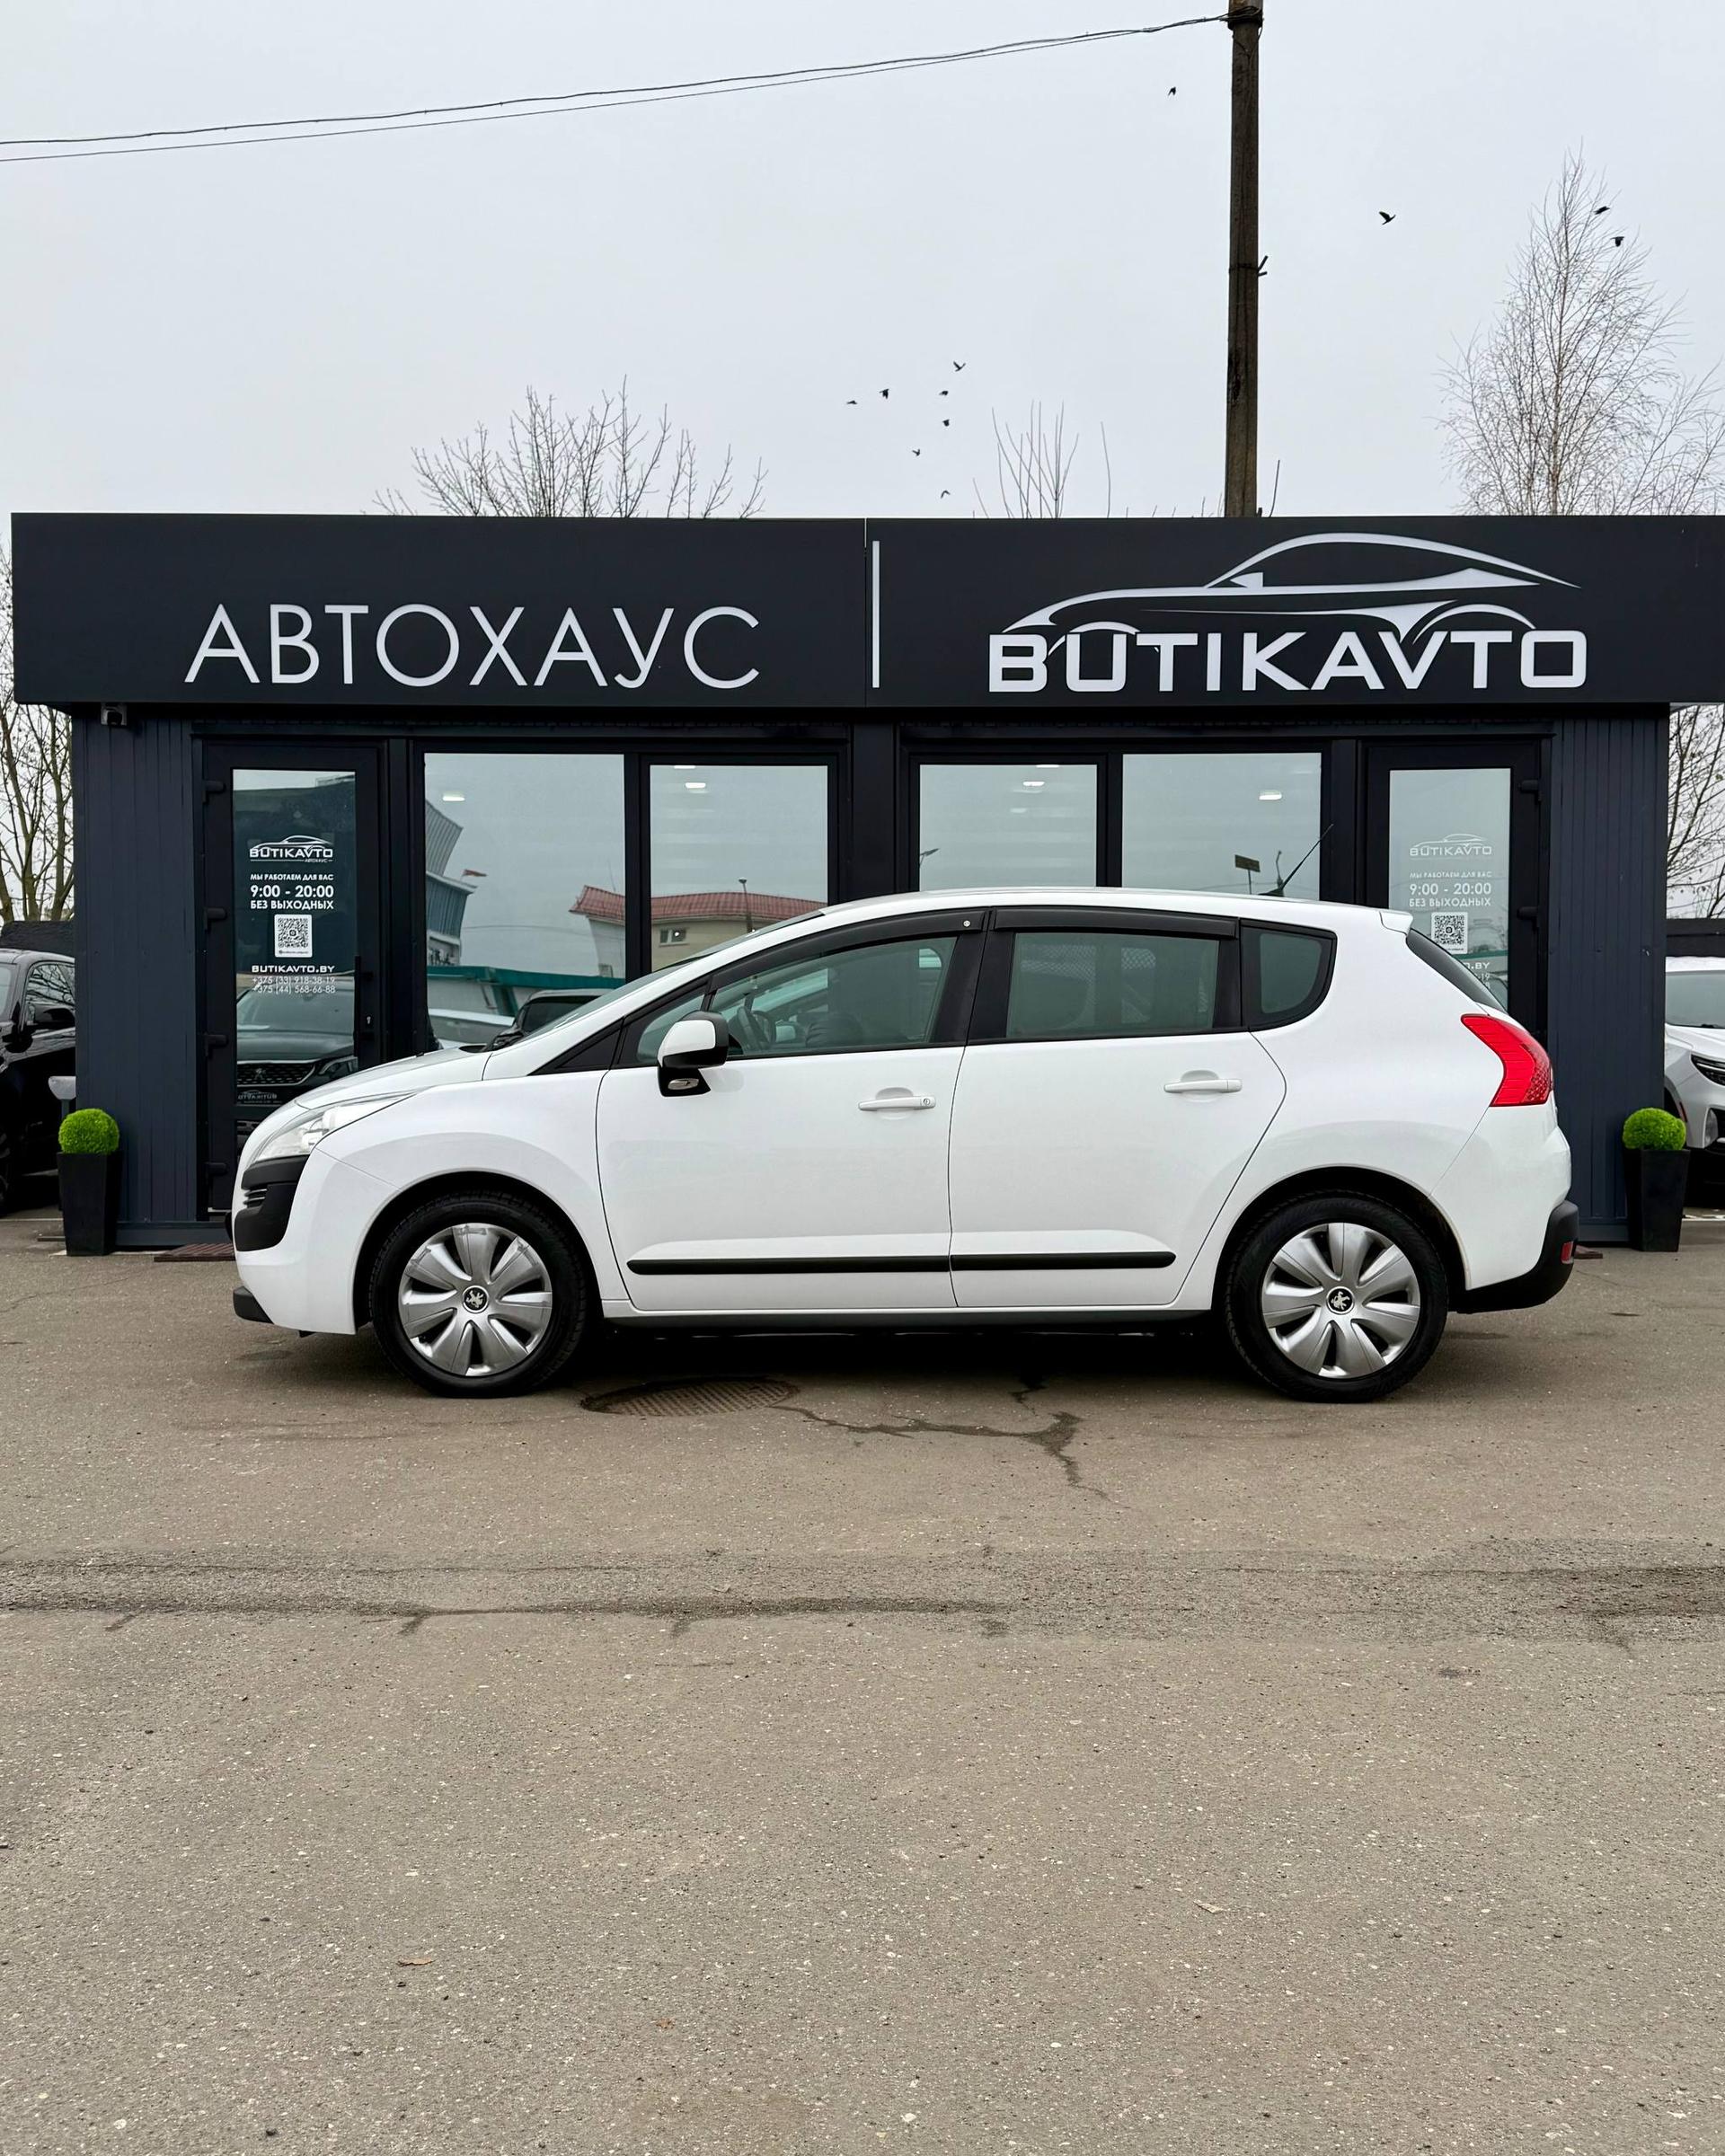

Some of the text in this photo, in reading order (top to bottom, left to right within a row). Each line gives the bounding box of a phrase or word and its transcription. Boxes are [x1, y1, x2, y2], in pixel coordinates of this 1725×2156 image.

[185, 604, 759, 689] АВТОХАУС
[989, 630, 1587, 693] BUTIKAVTO
[250, 848, 333, 858] BUTIKAVTO
[1410, 846, 1491, 856] BUTIKAVTO
[251, 885, 280, 897] 9:00
[295, 885, 334, 897] 20:00
[1410, 883, 1438, 896] 9:00
[1454, 882, 1491, 895] 20:00
[251, 900, 334, 910] БЕЗ ВЫХОДНЫХ
[1410, 897, 1491, 907] БЕЗ ВЫХОДНЫХ
[252, 965, 335, 973] BUTIKAVTO.BY
[252, 976, 273, 985] +375
[275, 976, 292, 985] (33)
[275, 985, 292, 994] (44)
[294, 985, 336, 994] 568-66-88
